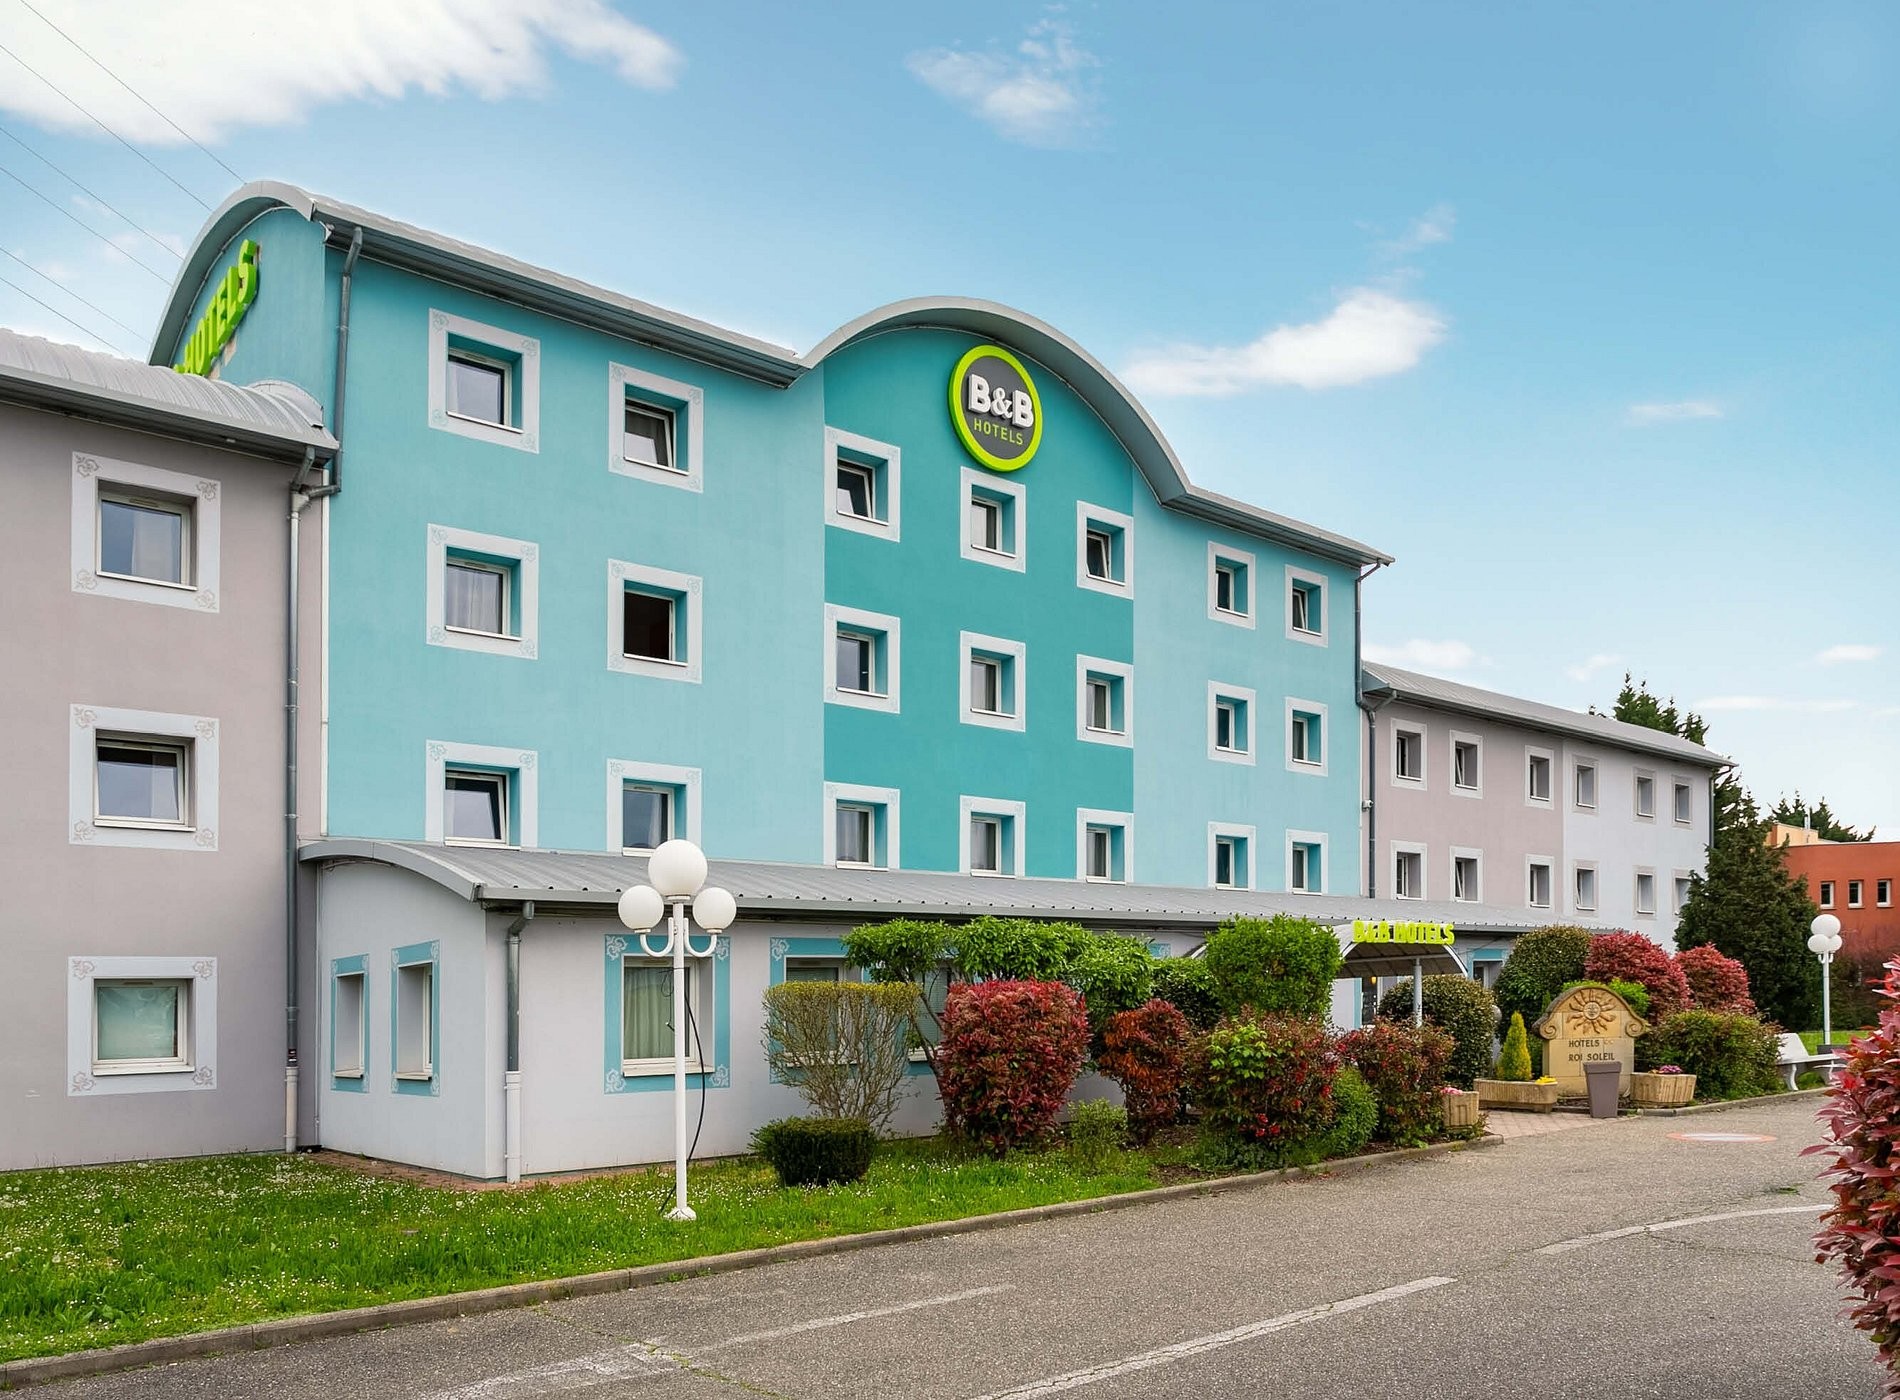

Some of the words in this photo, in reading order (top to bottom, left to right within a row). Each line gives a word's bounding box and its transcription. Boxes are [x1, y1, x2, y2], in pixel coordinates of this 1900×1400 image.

[969, 374, 1034, 427] B&B
[974, 418, 1023, 445] HOTELS
[1394, 922, 1455, 944] HOTELS
[1568, 1039, 1600, 1048] HOTELS
[1568, 1053, 1583, 1062] ROI
[1587, 1052, 1616, 1061] SOLEIL
